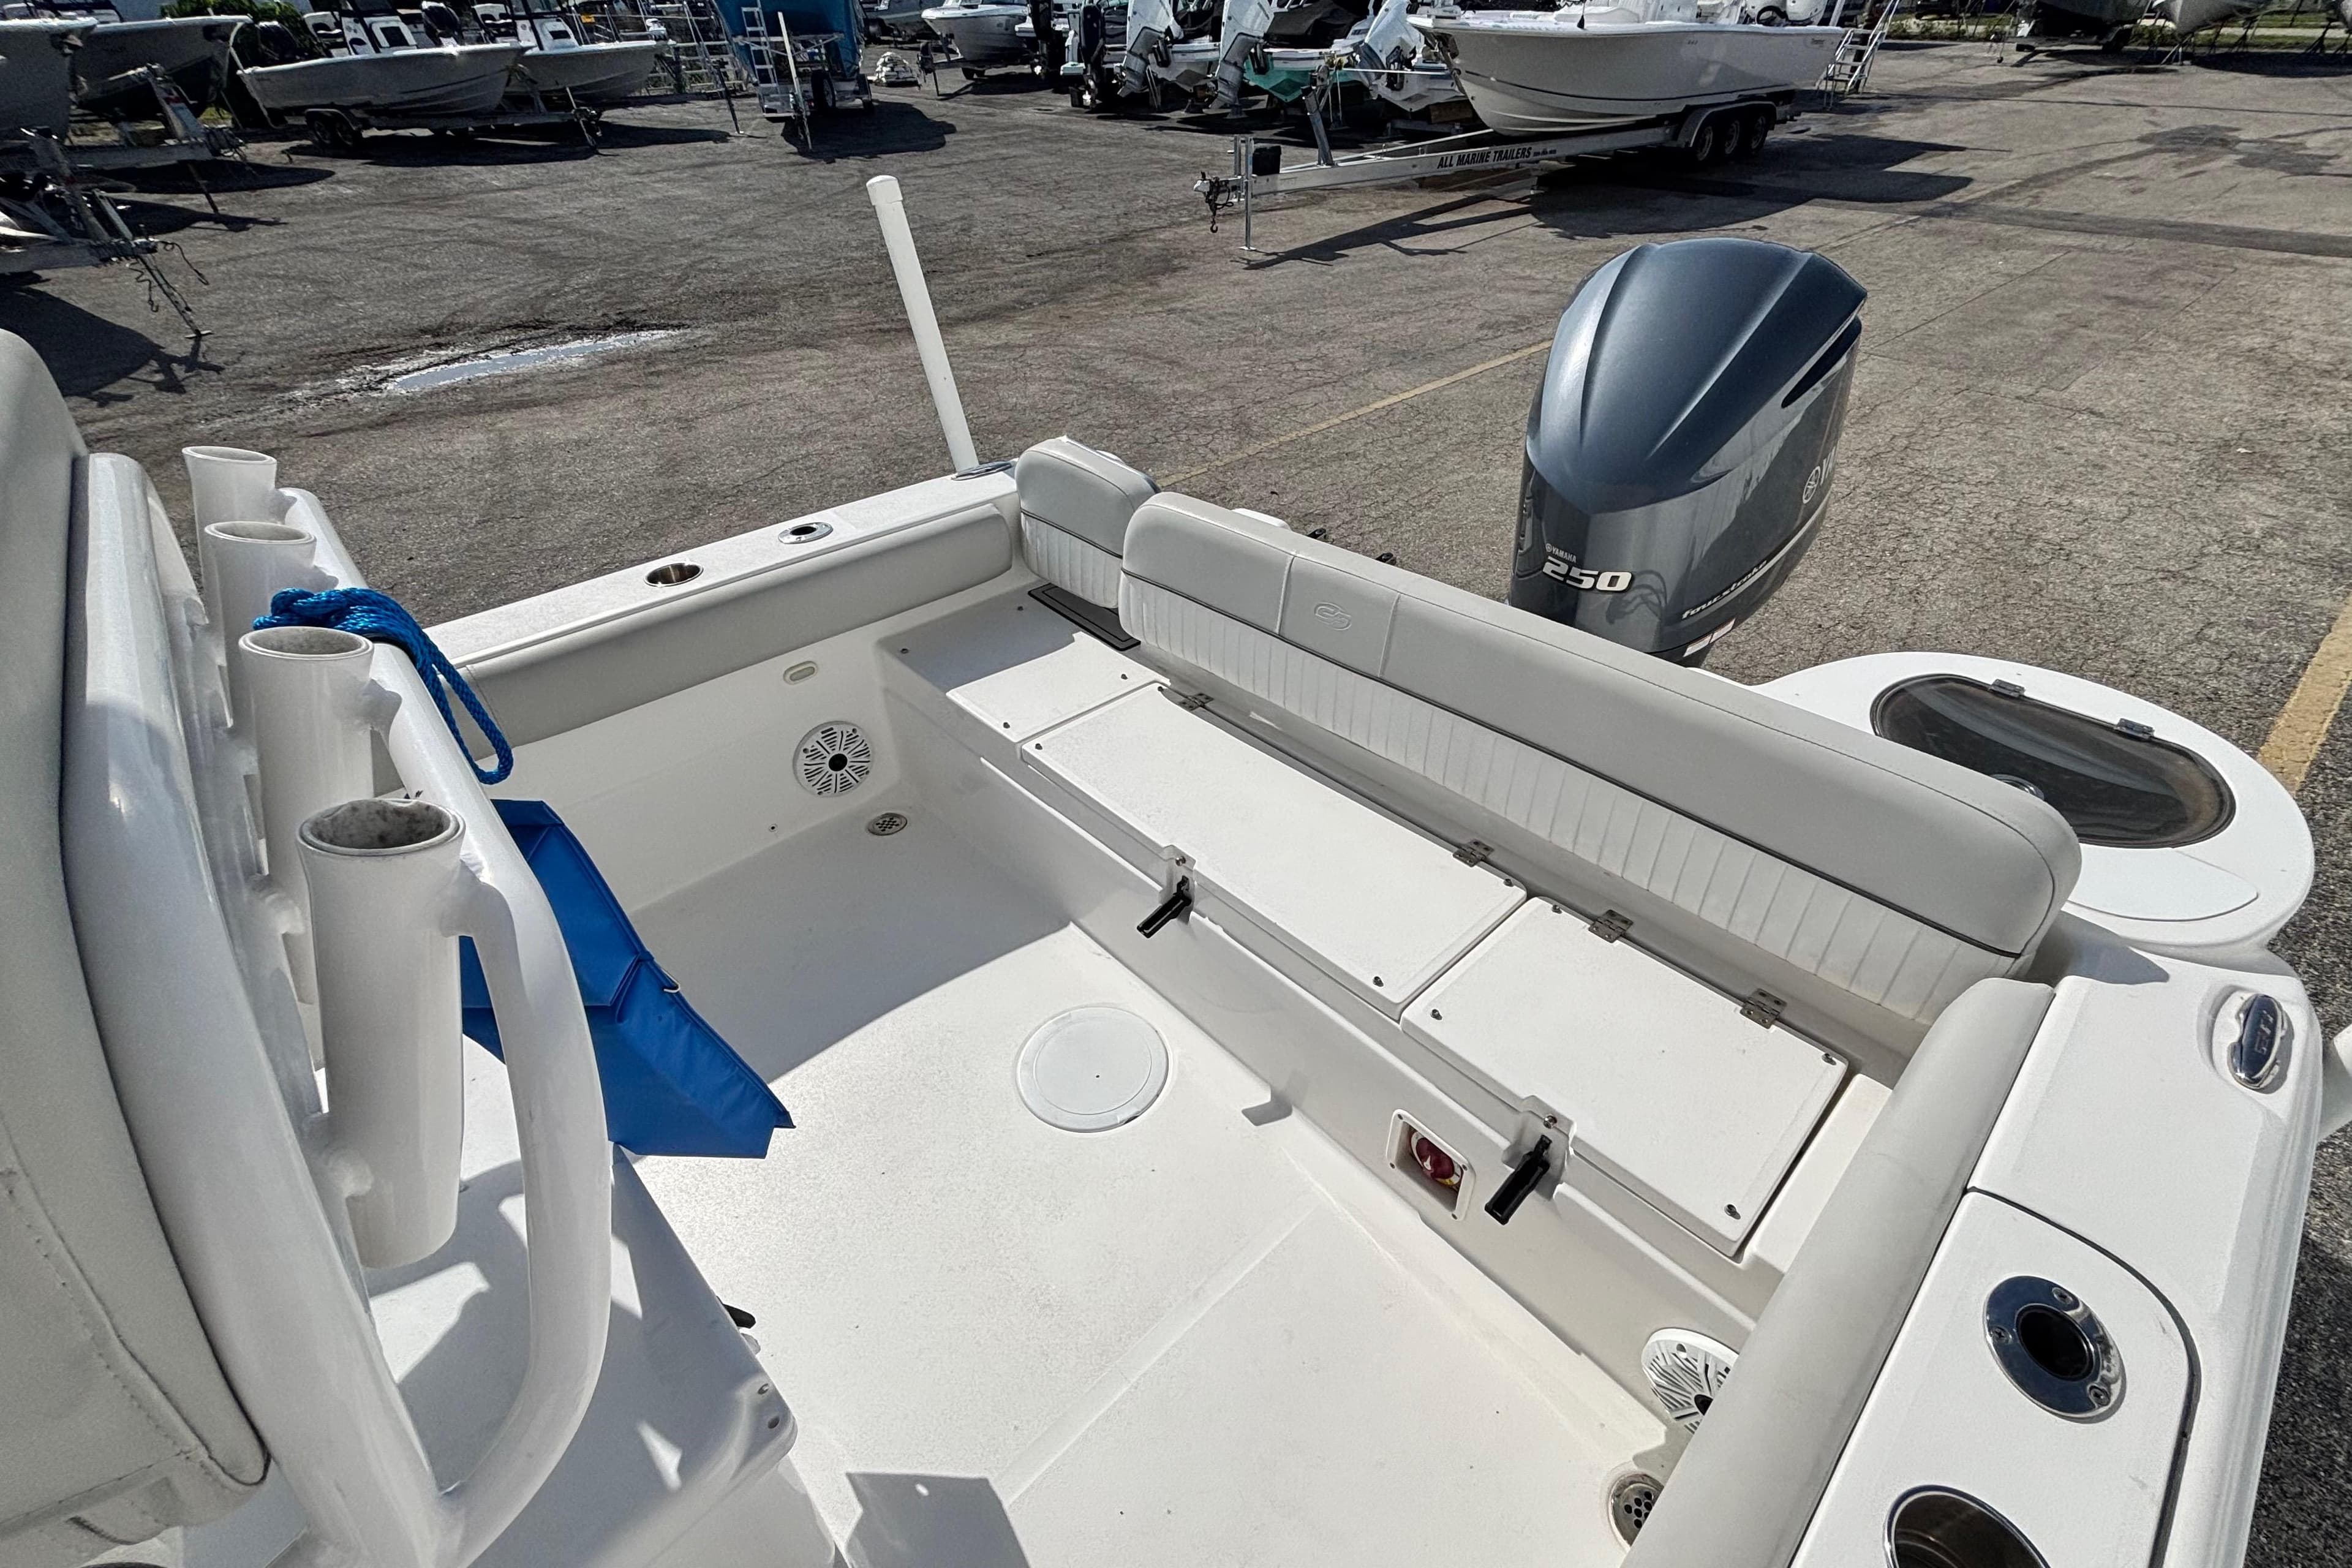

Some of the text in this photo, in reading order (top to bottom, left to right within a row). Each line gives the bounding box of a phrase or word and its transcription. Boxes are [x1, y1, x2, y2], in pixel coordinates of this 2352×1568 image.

[1437, 155, 1454, 169] ALL
[1456, 151, 1491, 167] MARINE
[1493, 146, 1532, 162] TRAILERS
[1552, 546, 1577, 564] YAMAHA
[1542, 555, 1633, 592] 250
